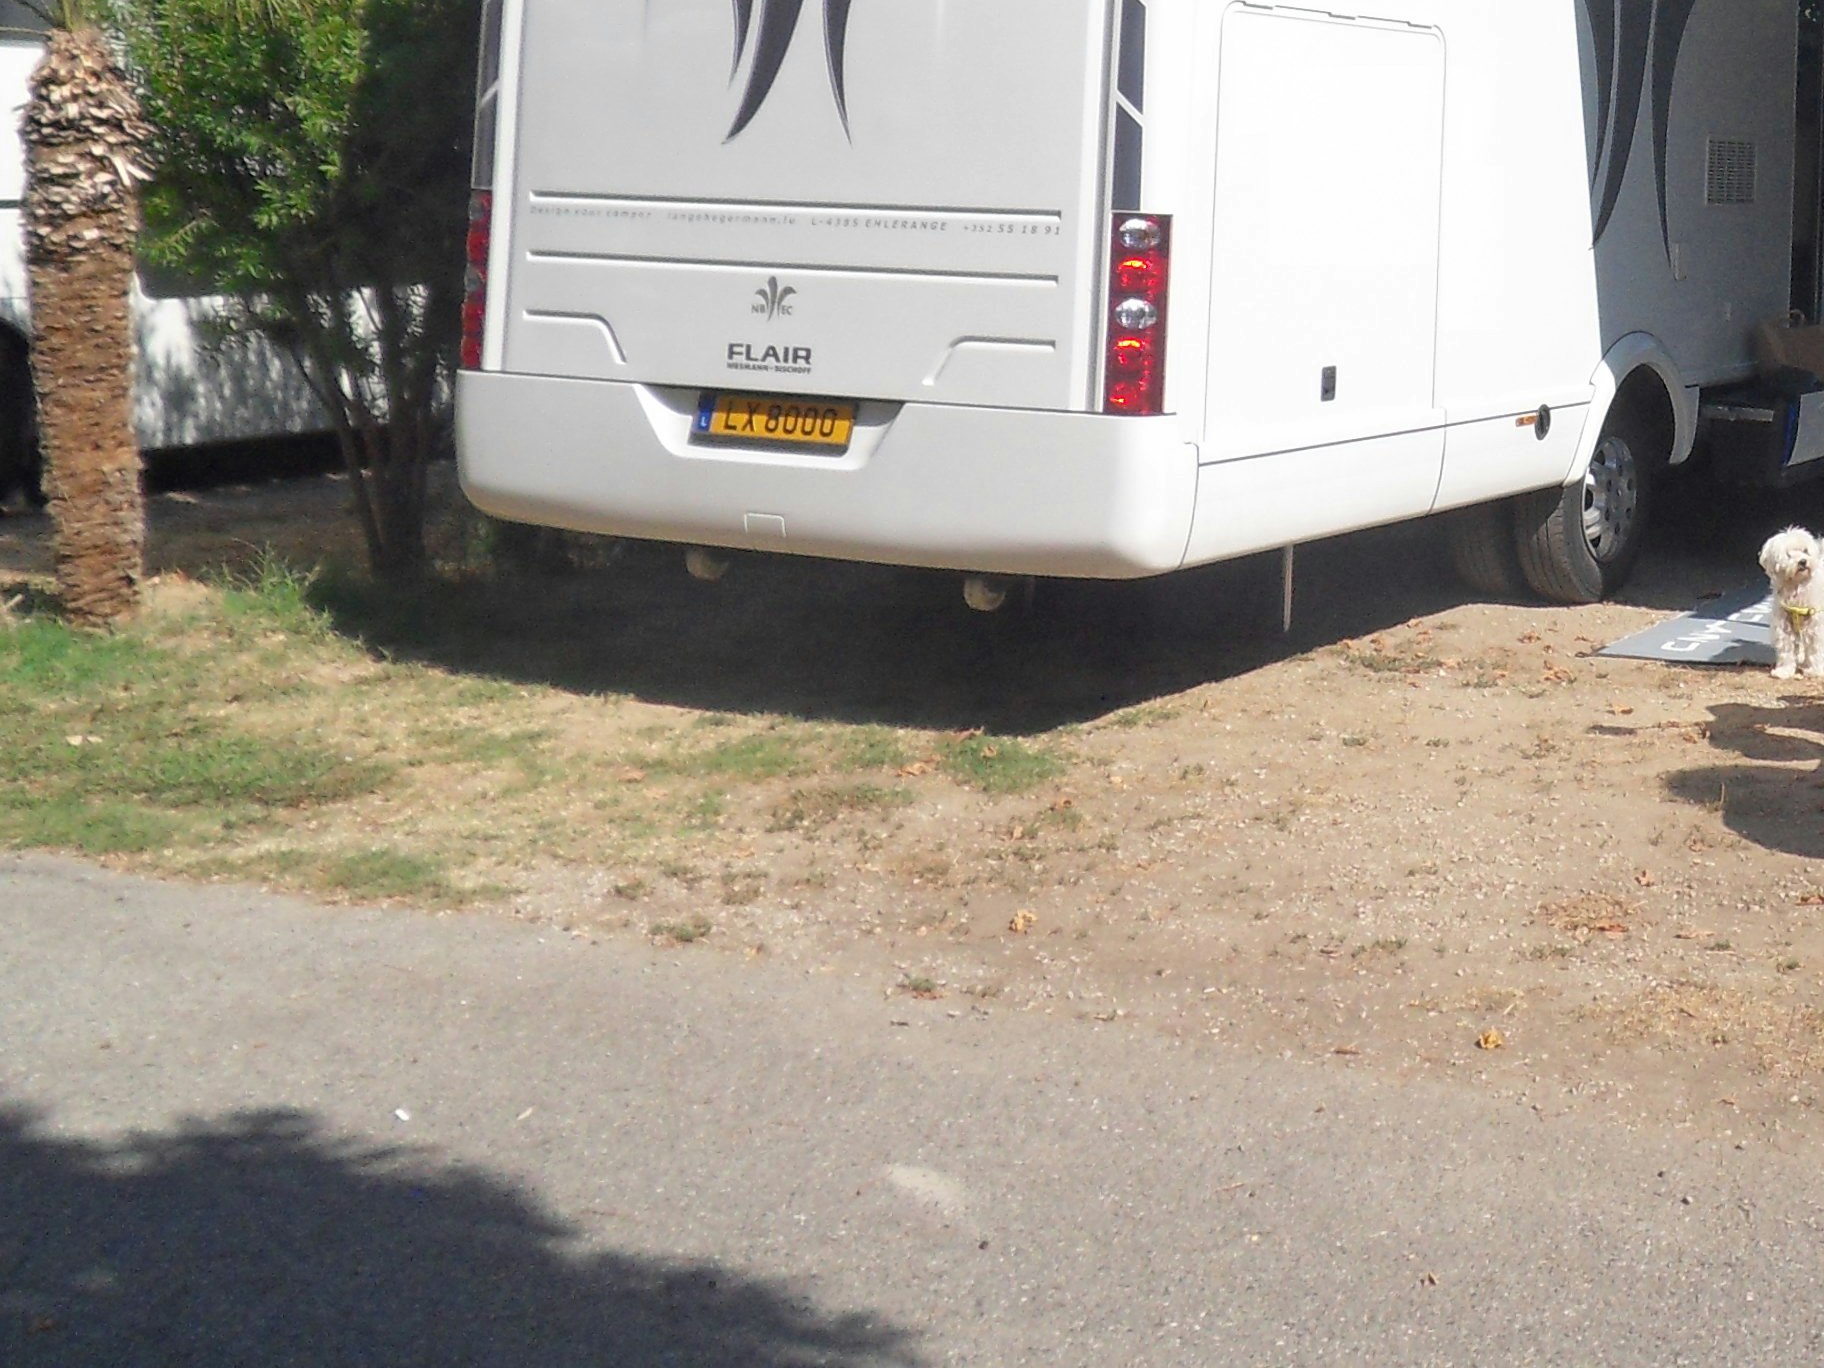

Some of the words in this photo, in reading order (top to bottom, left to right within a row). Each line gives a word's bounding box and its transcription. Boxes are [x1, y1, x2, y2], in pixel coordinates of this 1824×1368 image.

[864, 218, 948, 231] EHLERANGE
[1021, 225, 1038, 235] 18
[1043, 225, 1060, 235] 91
[727, 342, 812, 366] FLAIR
[723, 401, 760, 432] LX
[764, 403, 838, 438] 8000
